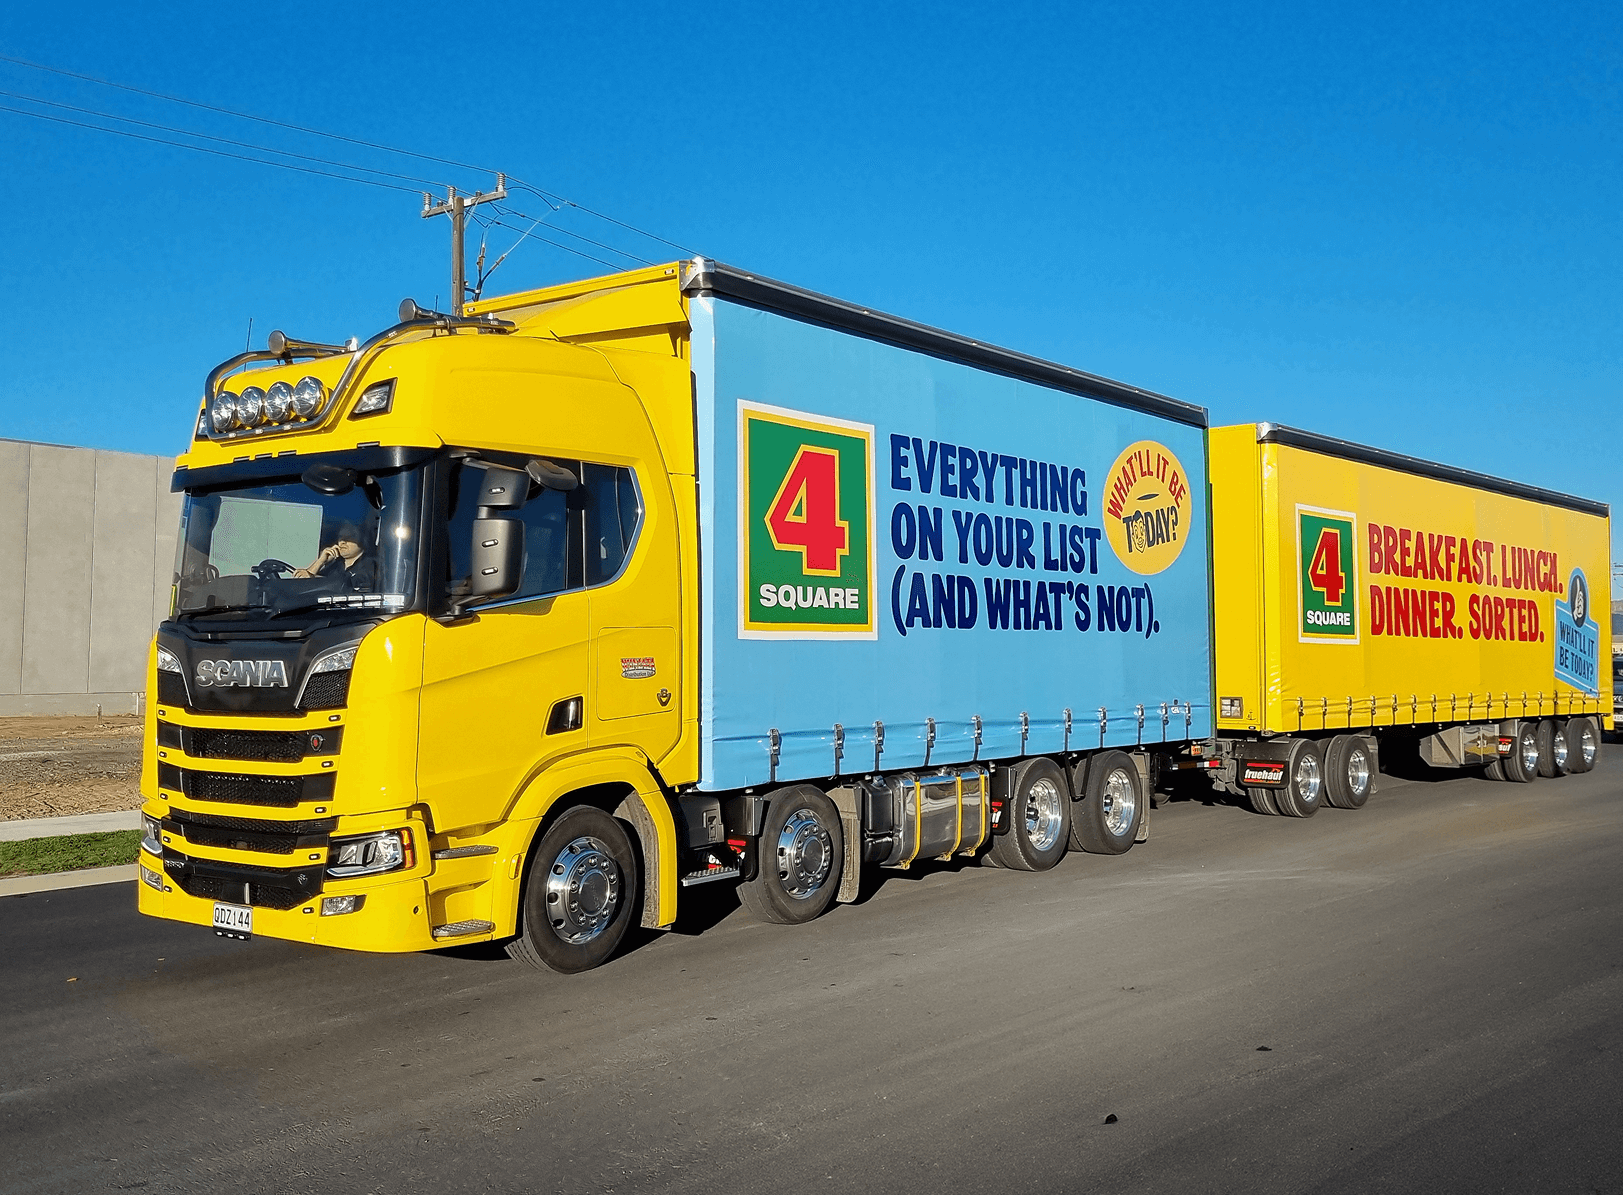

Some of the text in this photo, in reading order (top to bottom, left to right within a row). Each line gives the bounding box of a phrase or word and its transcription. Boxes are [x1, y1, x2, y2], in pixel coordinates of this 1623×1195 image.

[889, 433, 1088, 517] EVERYTHING
[1107, 449, 1187, 520] WHAT'LL IT BE
[764, 443, 850, 578] 4
[890, 502, 1102, 575] ON YOUR LIST
[1308, 527, 1346, 607] 4
[1368, 522, 1498, 587] BREAKFAST.
[759, 583, 860, 611] SQUARE
[891, 564, 1160, 640] (AND WHAT'S NOT).
[1306, 610, 1351, 627] SQUARE
[1369, 584, 1545, 643] DINNER. SORTED.
[1559, 620, 1595, 659] WHAT'LL IT
[1559, 645, 1594, 682] BE TODAY?
[195, 659, 289, 688] SCANIA
[1244, 768, 1284, 781] fruehauf
[214, 907, 250, 929] QDZ144
